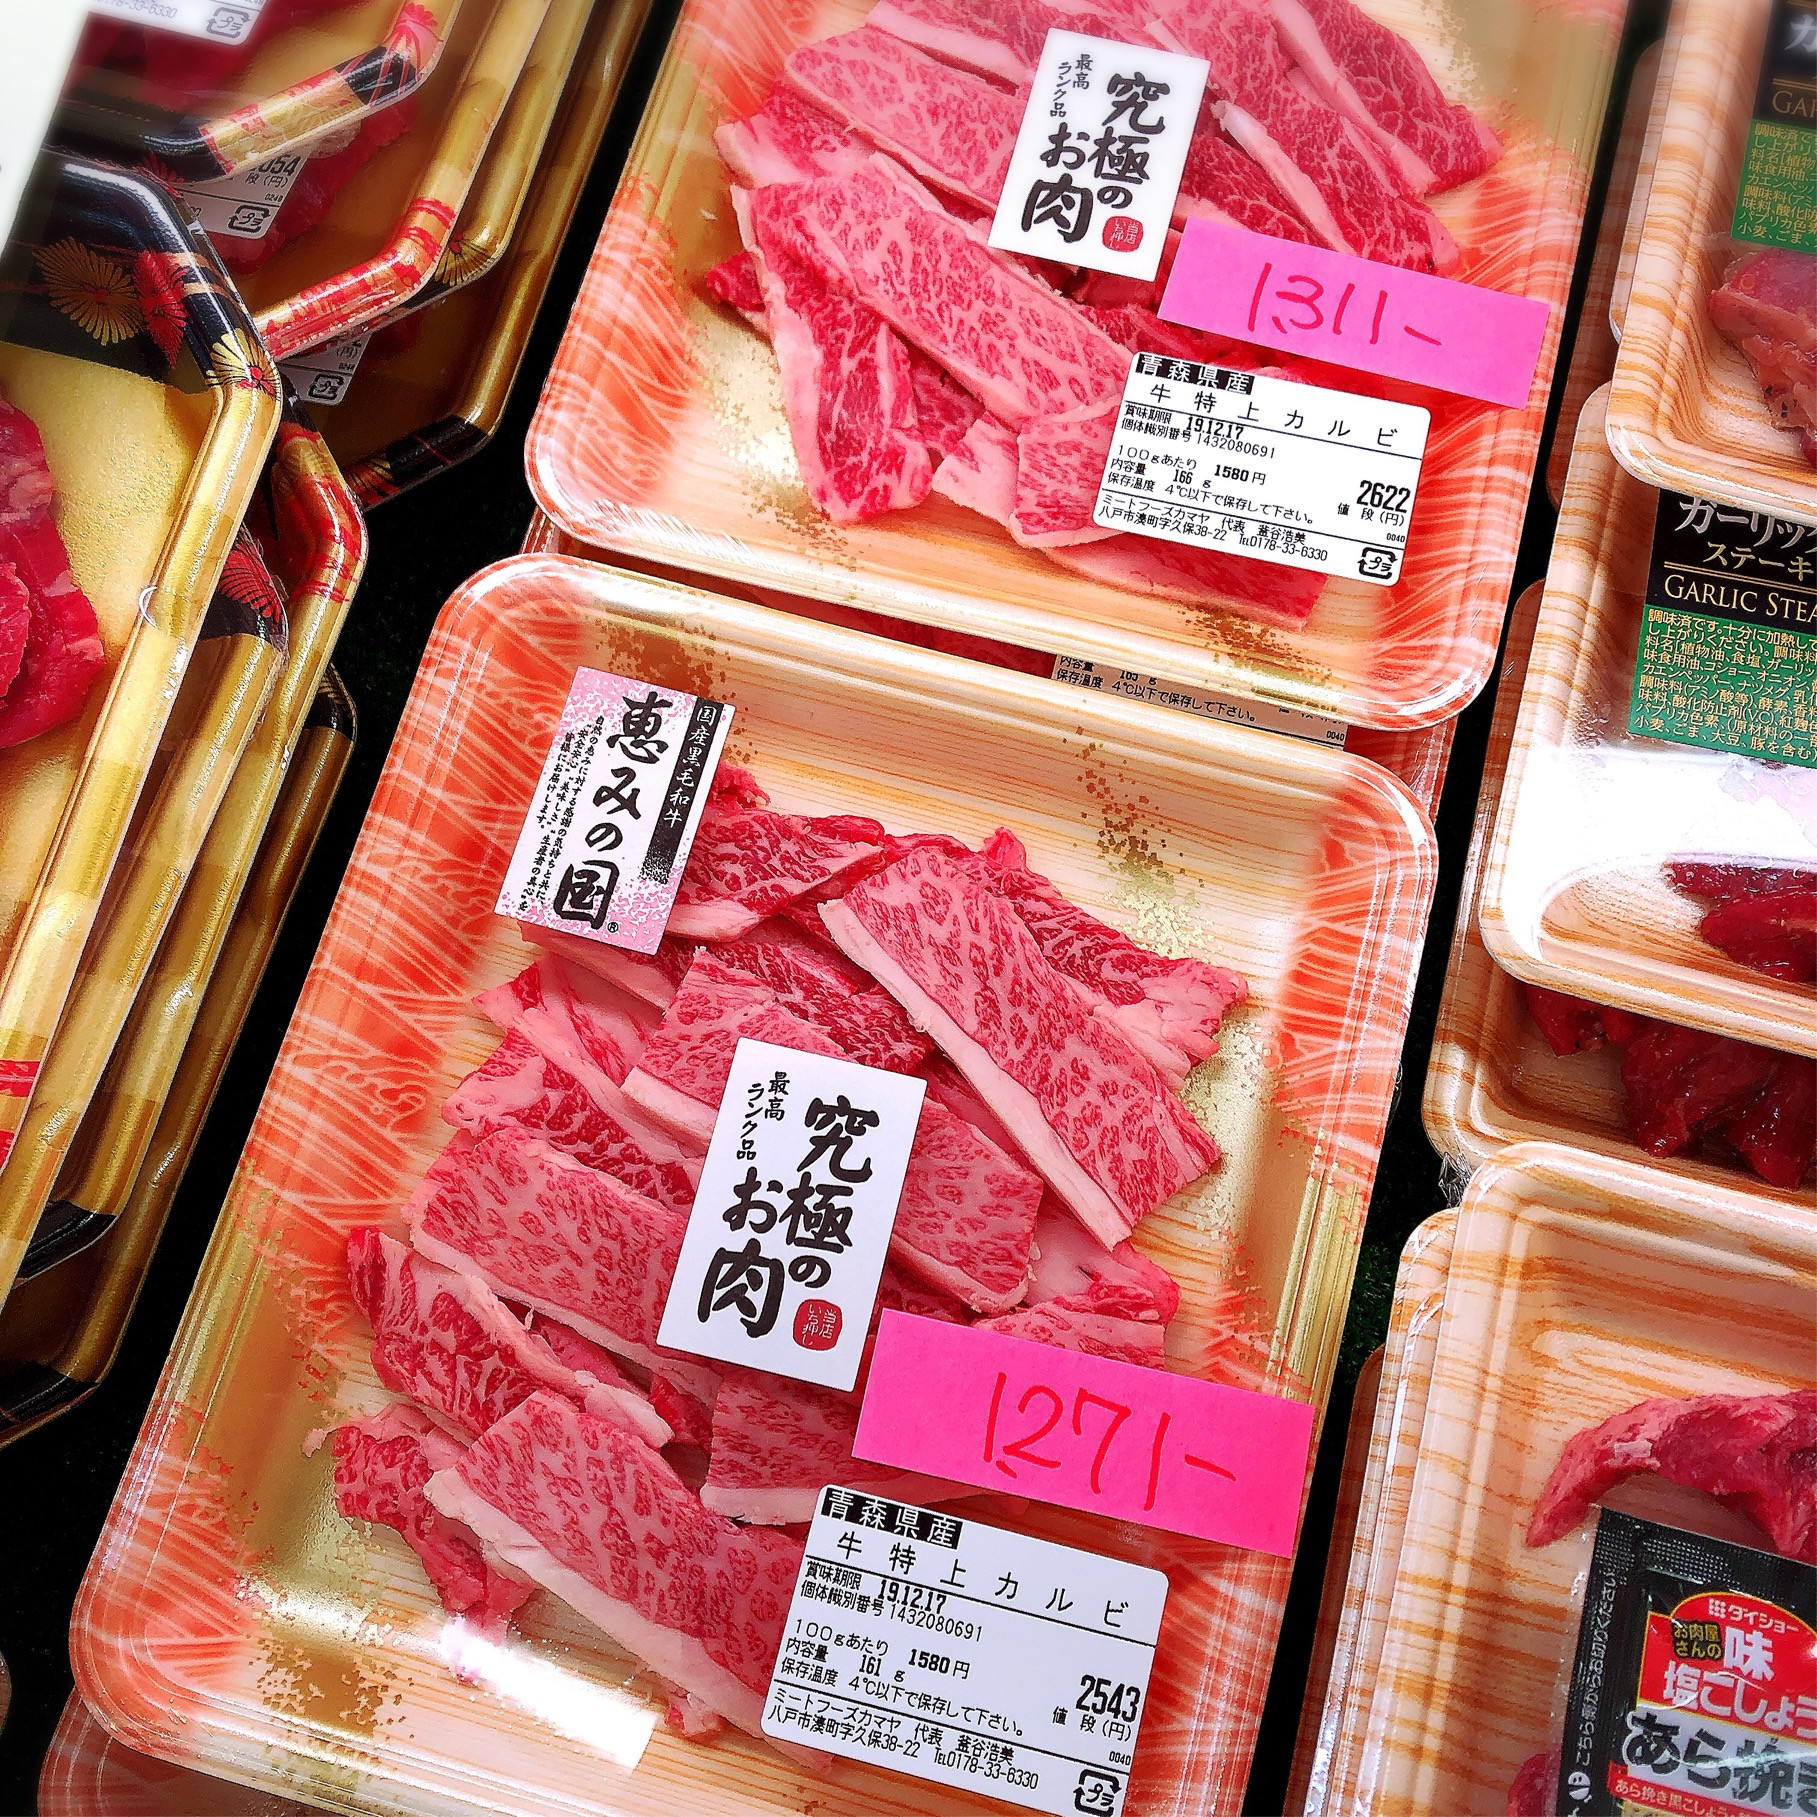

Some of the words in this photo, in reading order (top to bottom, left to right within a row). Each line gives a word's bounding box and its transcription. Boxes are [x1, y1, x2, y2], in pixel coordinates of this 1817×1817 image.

[1049, 61, 1072, 118] ランク品
[1072, 54, 1093, 89] 最高
[1087, 71, 1171, 209] 究極の
[1021, 122, 1094, 243] お肉
[1139, 353, 1253, 395] 青森県産
[1124, 404, 1173, 425] 賞味期限
[1186, 416, 1245, 440] 19.12.17
[1197, 433, 1275, 459] 1432080691
[1107, 470, 1156, 493] 保存温度
[1110, 457, 1147, 476] 内容量
[1172, 469, 1194, 485] 166
[1356, 479, 1412, 514] 2622
[1221, 516, 1246, 534] 代表
[1702, 541, 1815, 582] ステーキ
[1664, 574, 1758, 613] GARLIC
[1056, 668, 1104, 689] 保存温度
[663, 705, 717, 829] 国産黒毛和牛
[764, 1071, 791, 1121] 最高
[736, 1082, 766, 1161] ランク品
[778, 1094, 880, 1289] 究極の
[697, 1167, 786, 1339] お肉
[827, 1489, 959, 1549] 青森県産
[804, 1560, 863, 1591] 賞味期限
[877, 1578, 948, 1615] 19.12.17
[800, 1579, 886, 1617] 個体識別番号
[890, 1603, 984, 1643] 1432080691
[1727, 1604, 1799, 1633] ダイショー
[1673, 1622, 1720, 1643] お肉屋
[1675, 1640, 1722, 1659] さんの
[780, 1656, 839, 1688] 保存温度
[785, 1636, 830, 1663] 内容量
[858, 1654, 883, 1677] 161
[1723, 1625, 1775, 1682] 味
[1075, 1673, 1142, 1723] 2543
[773, 1686, 902, 1731] ミートフーズカマヤ
[914, 1722, 945, 1748] 代表
[956, 1733, 1016, 1767] 釜谷浩美
[1108, 1750, 1132, 1766] 0040
